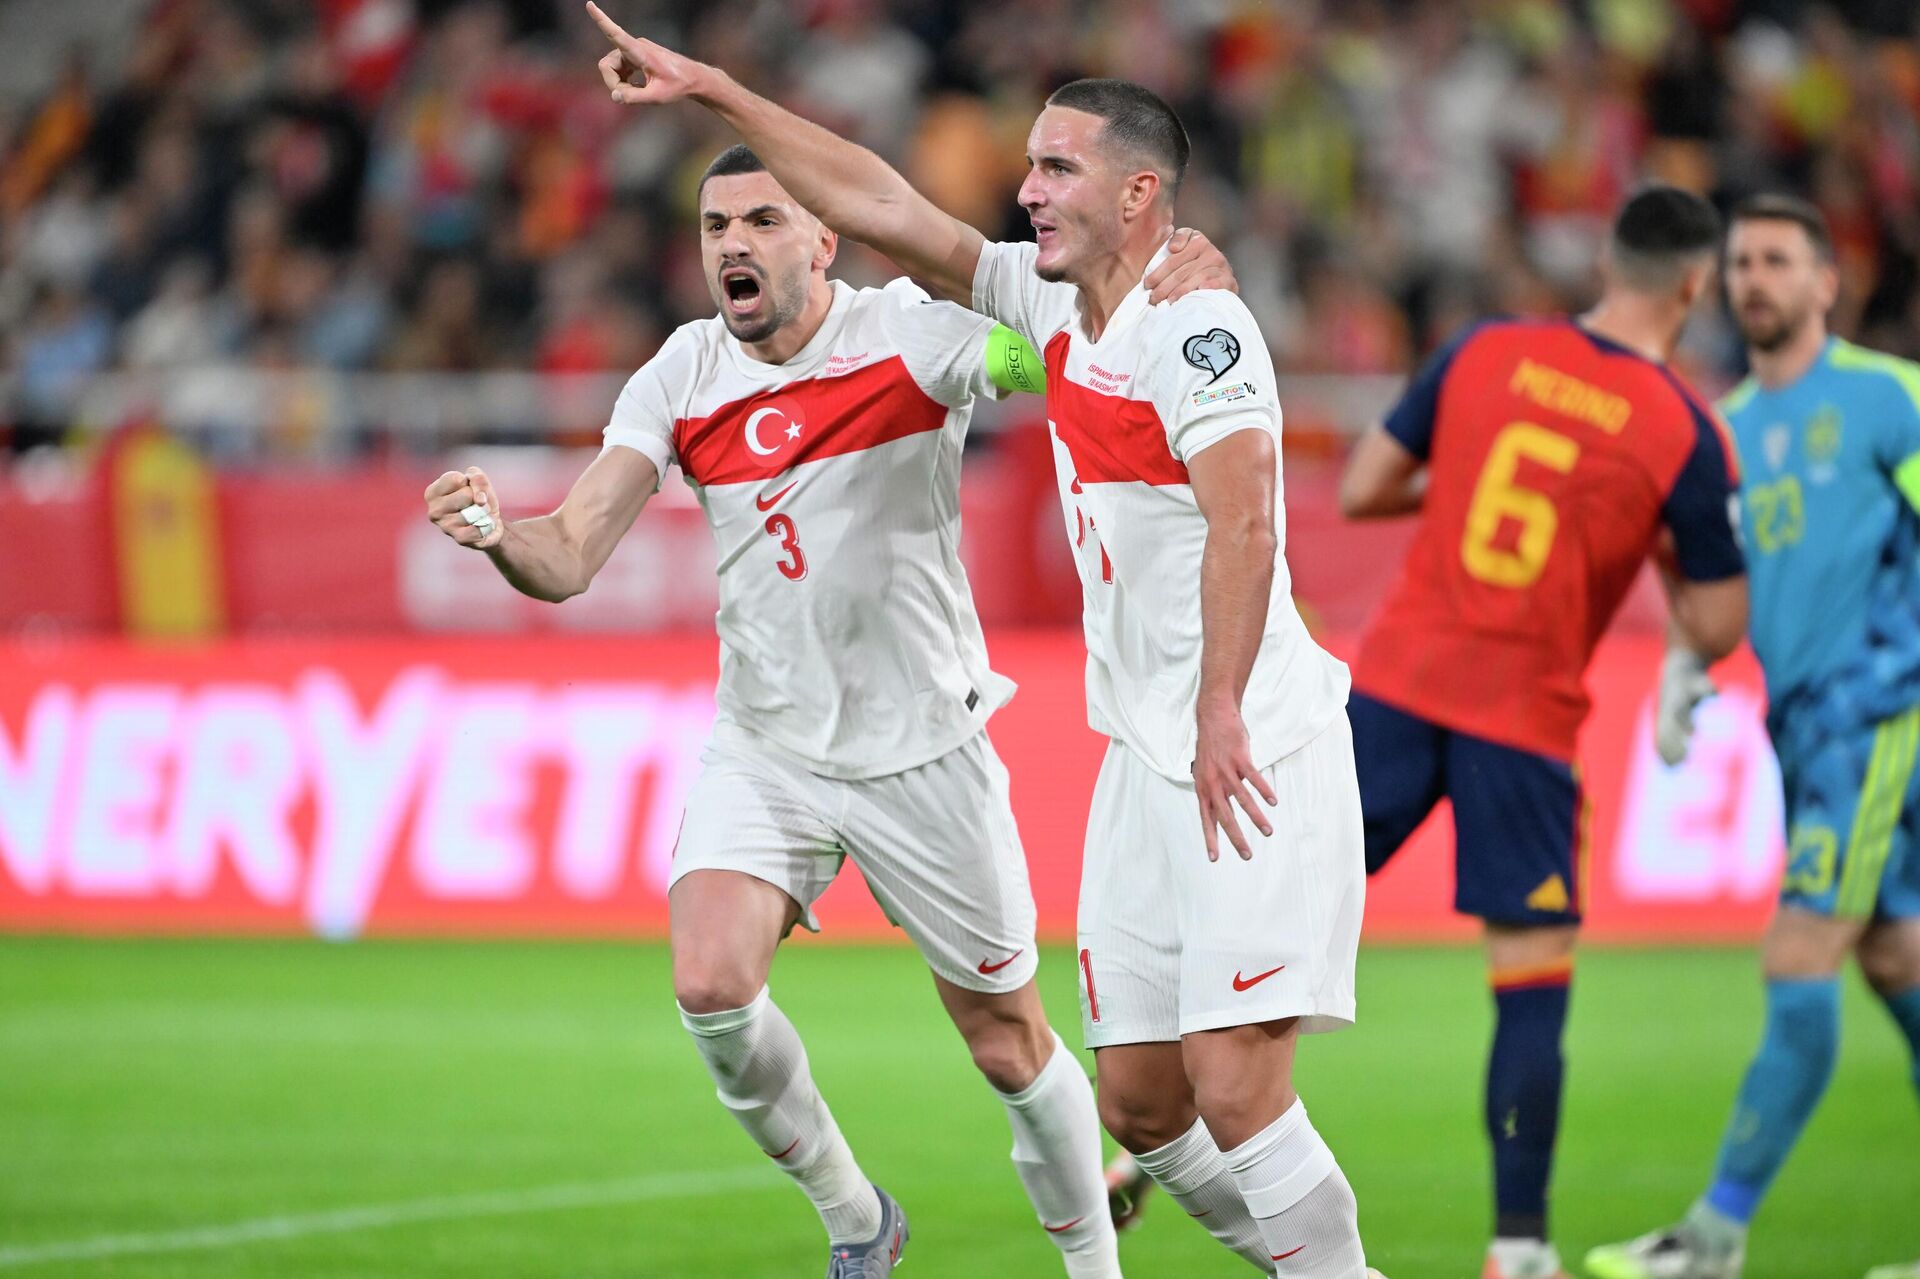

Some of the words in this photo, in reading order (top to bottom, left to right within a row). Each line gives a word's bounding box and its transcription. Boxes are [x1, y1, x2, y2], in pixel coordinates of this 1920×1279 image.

[1009, 344, 1031, 388] RESPECT
[1193, 386, 1245, 405] FOUNDATION
[1461, 421, 1579, 588] 6
[1747, 473, 1804, 556] 23
[765, 513, 808, 582] 3
